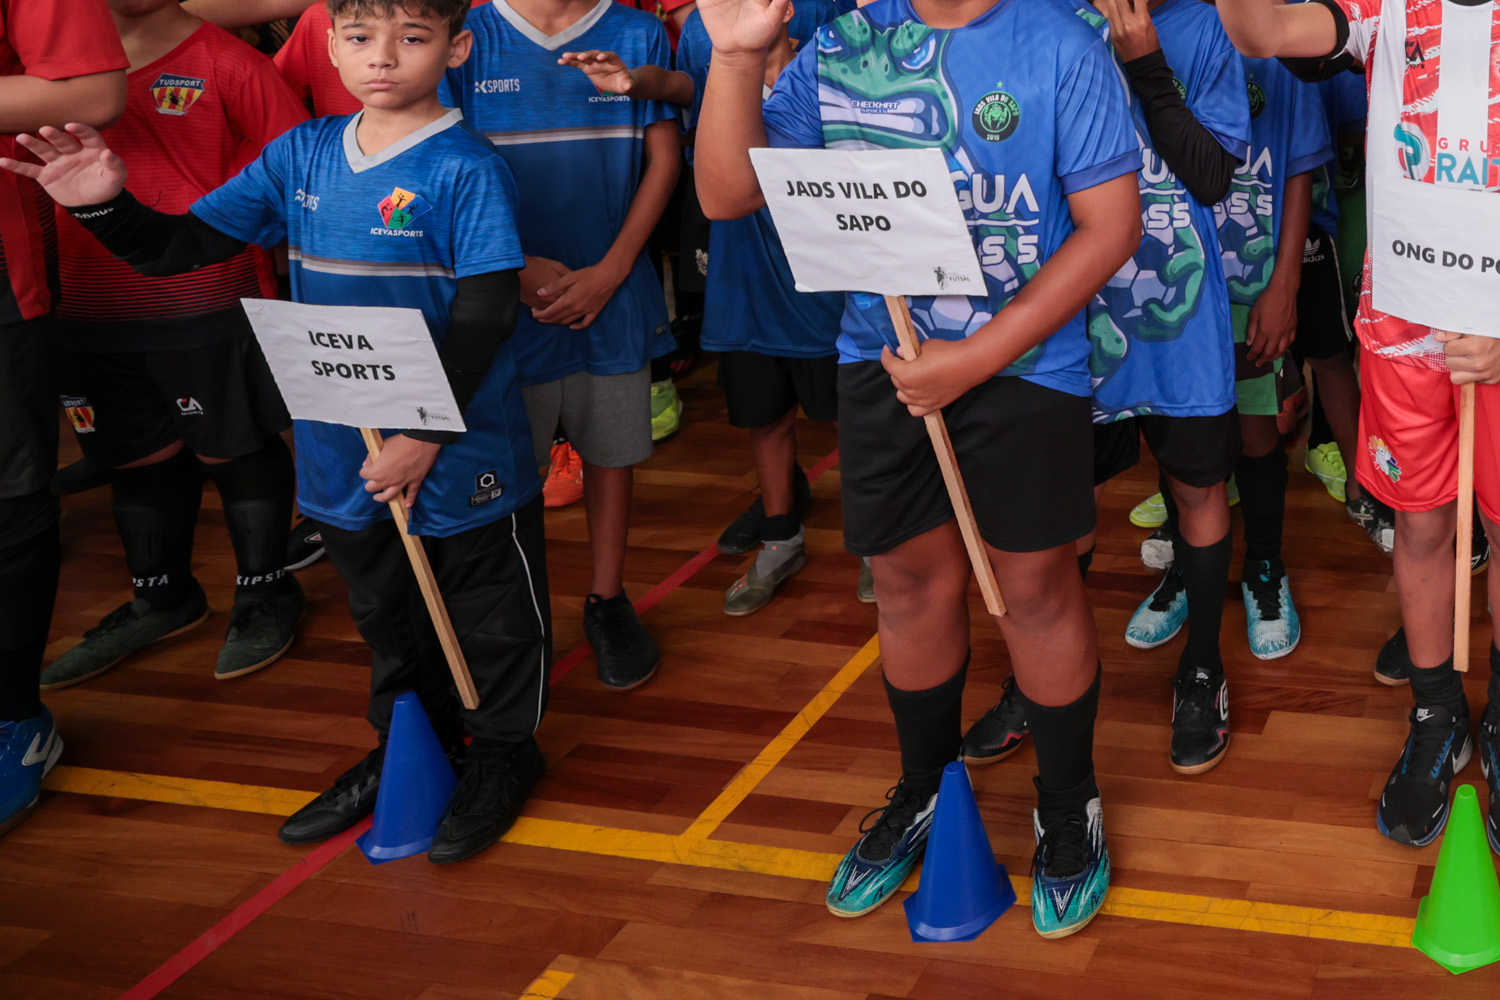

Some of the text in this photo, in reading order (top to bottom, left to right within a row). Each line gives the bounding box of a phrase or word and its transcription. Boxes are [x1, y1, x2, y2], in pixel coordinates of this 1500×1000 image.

[159, 79, 201, 87] TUDSPORT
[588, 95, 630, 103] ICEVASPORTS
[851, 100, 900, 111] CHECKMAT
[973, 100, 986, 115] JADS
[985, 94, 1000, 103] VILA
[1008, 100, 1019, 116] SAPO
[786, 180, 927, 199] JADS VILA DO
[836, 213, 891, 232] SAPO
[370, 227, 424, 238] ICEVASPORTS
[1392, 239, 1436, 264] ONG
[1442, 250, 1474, 270] DO
[308, 331, 374, 351] ICEVA
[311, 360, 396, 381] SPORTS
[176, 397, 203, 411] CA
